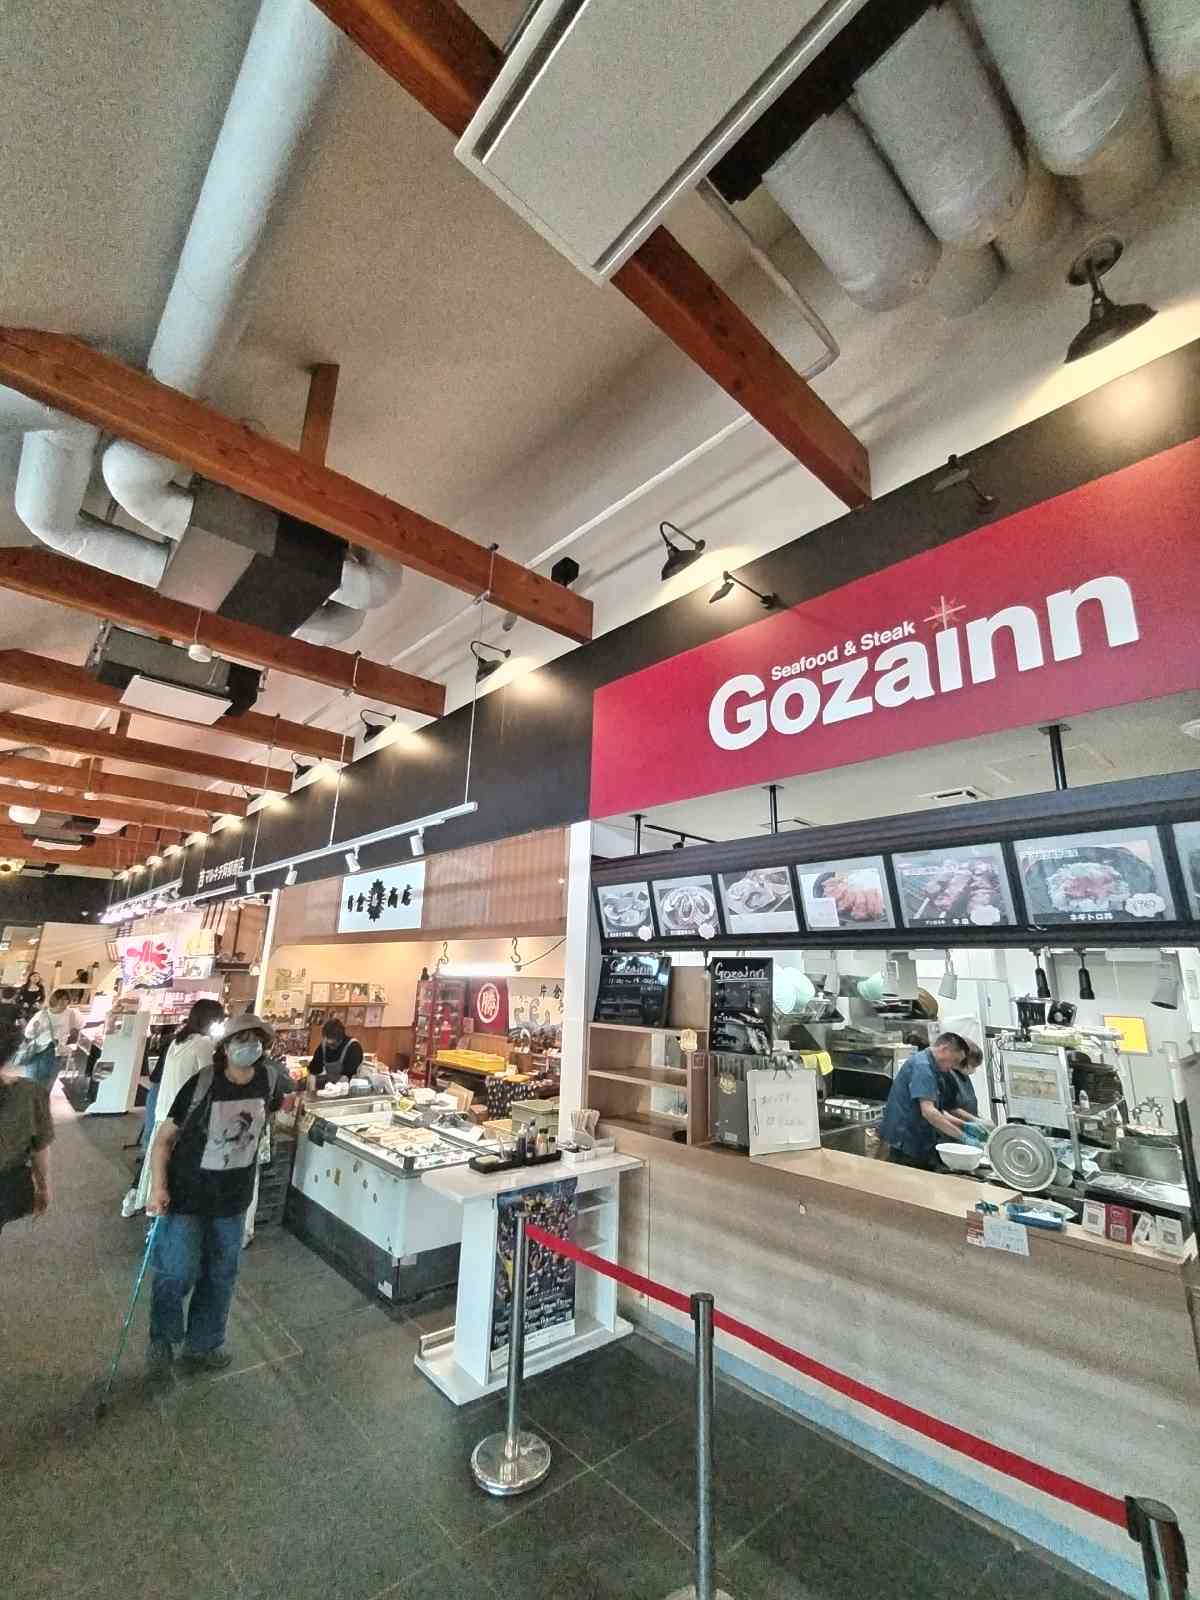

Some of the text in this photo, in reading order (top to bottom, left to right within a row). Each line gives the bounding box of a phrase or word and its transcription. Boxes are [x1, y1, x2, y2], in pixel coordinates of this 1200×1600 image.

[708, 575, 1140, 751] Gozainn
[771, 619, 916, 682] Seafood & Steak
